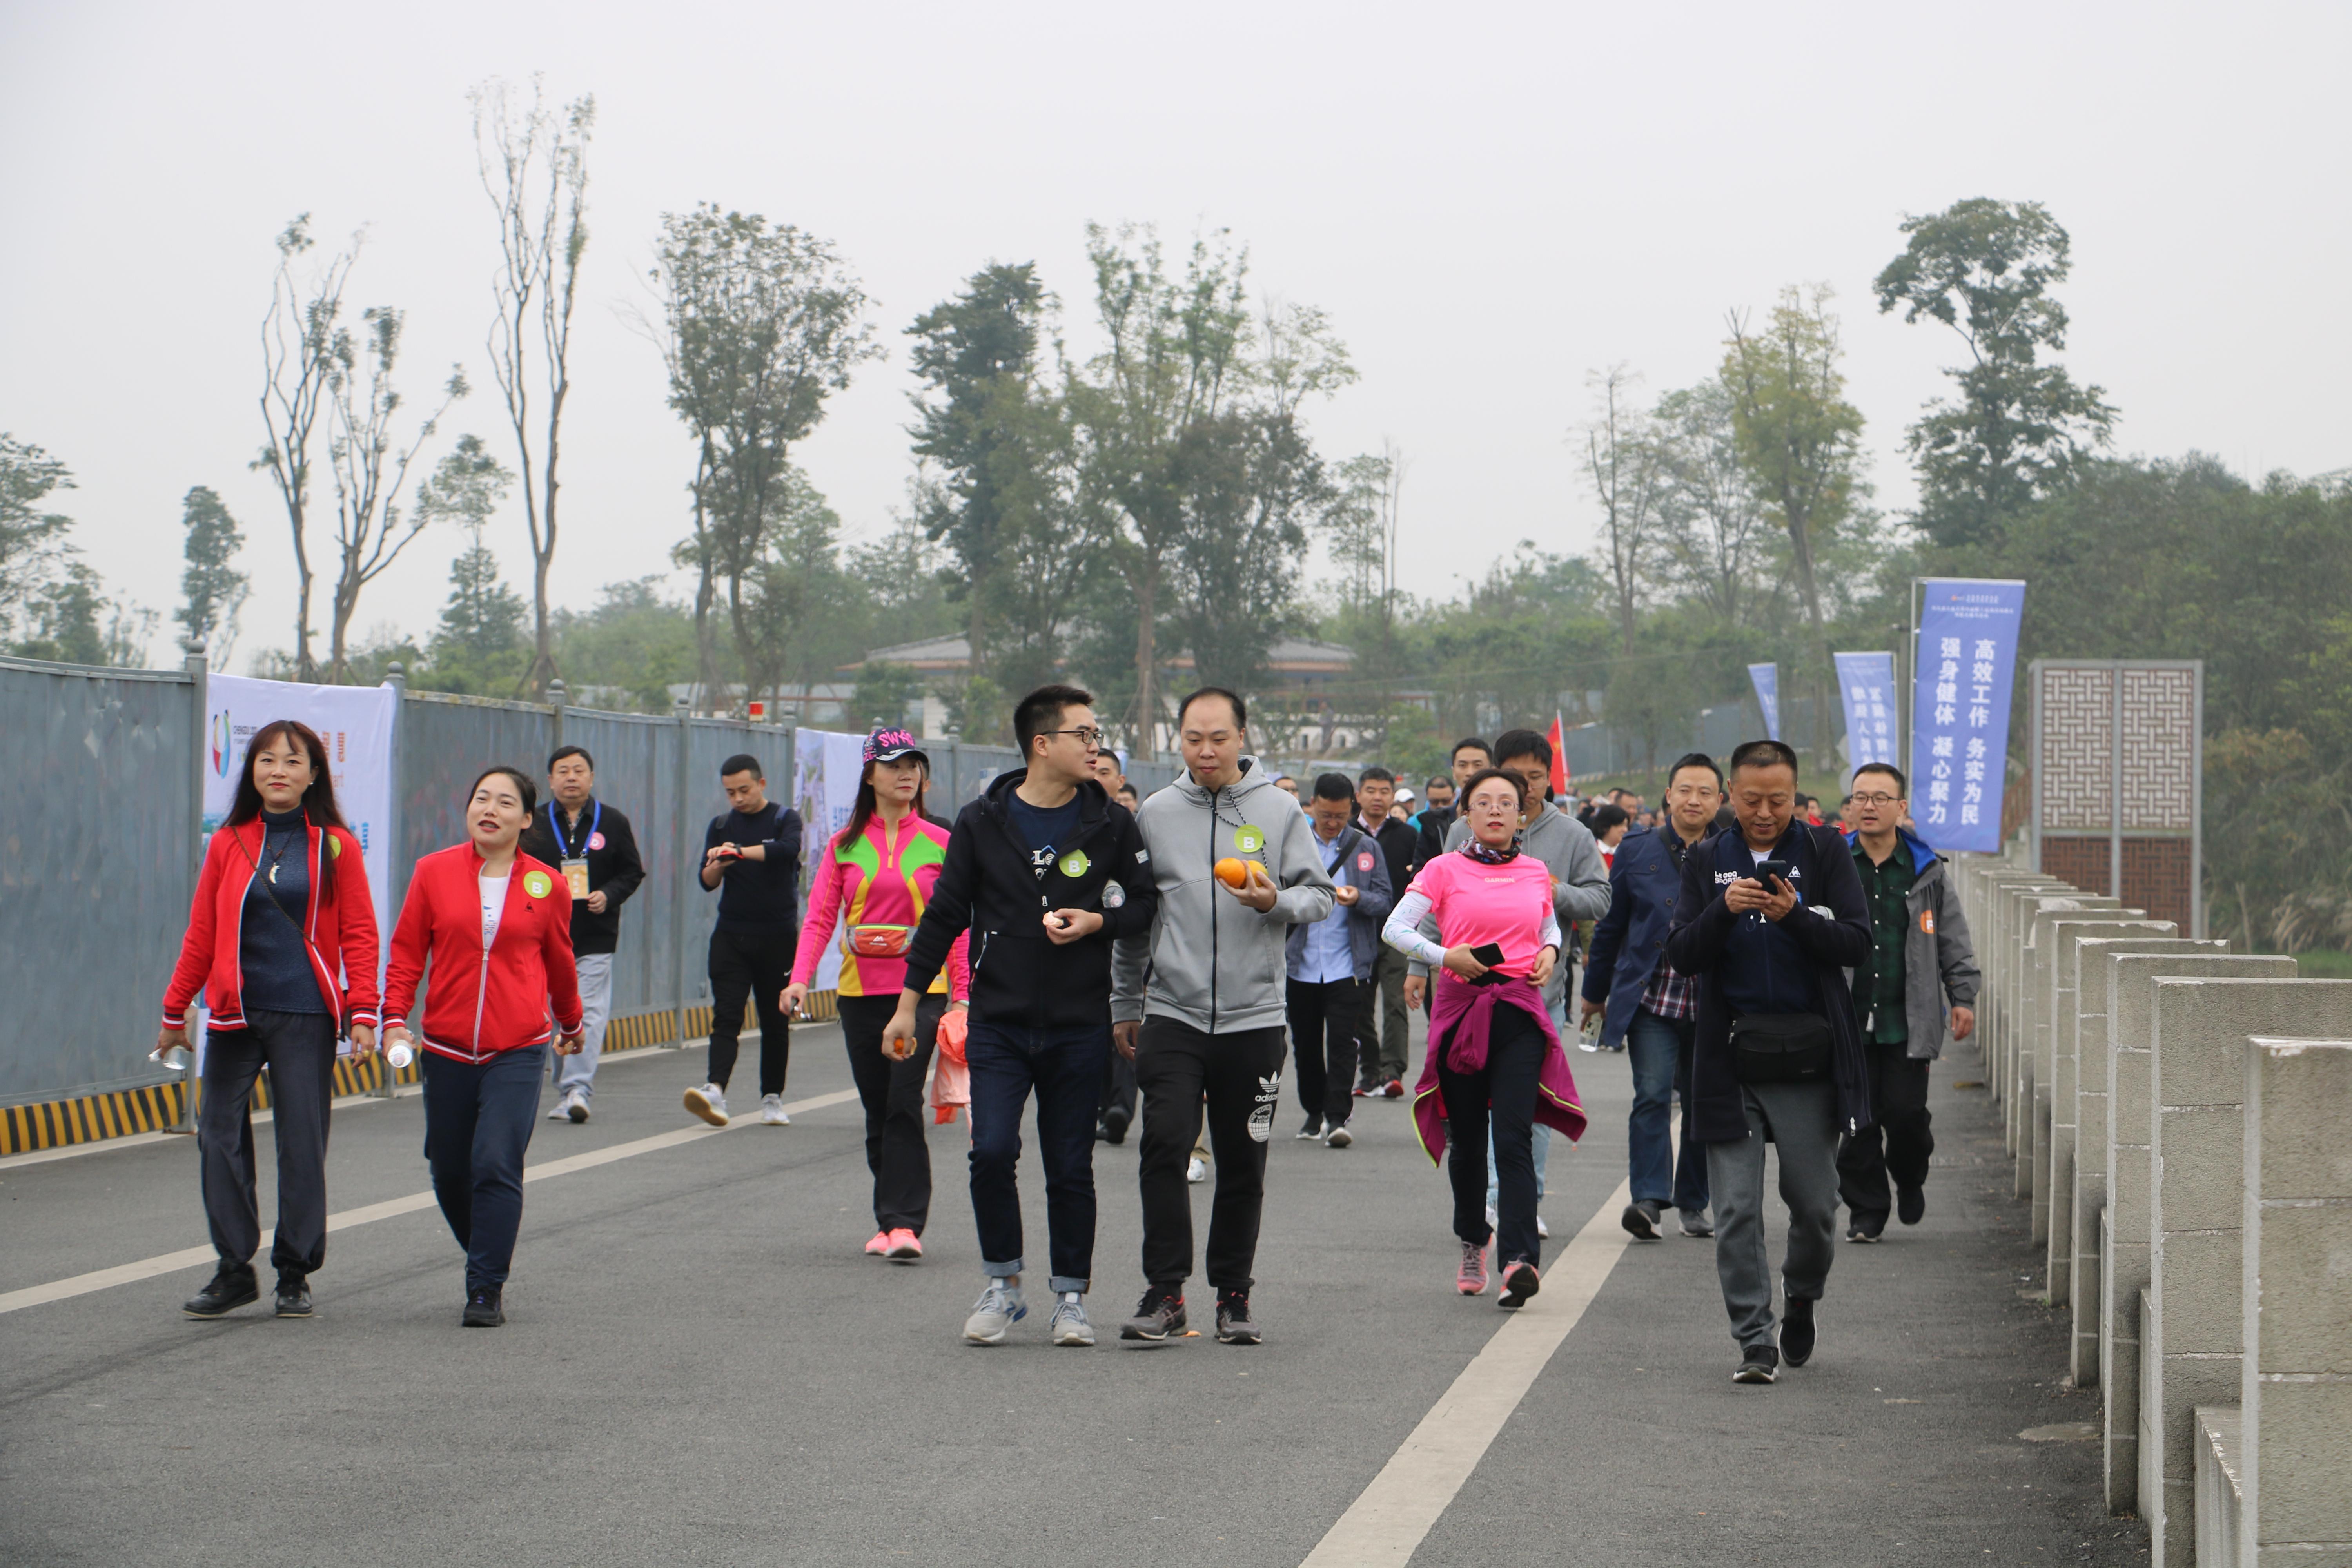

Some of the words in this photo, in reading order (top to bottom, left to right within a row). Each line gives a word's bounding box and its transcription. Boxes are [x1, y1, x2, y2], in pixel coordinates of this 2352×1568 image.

[1934, 637, 1961, 726] 强身健体
[1968, 639, 1996, 728] 高效工作
[1928, 737, 1953, 825] 凝心聚力
[1961, 737, 1987, 826] 务实为民
[1243, 836, 1255, 848] B
[1069, 860, 1080, 873] B
[1361, 860, 1369, 868] D
[532, 881, 543, 894] B
[1255, 1093, 1279, 1102] adidas
